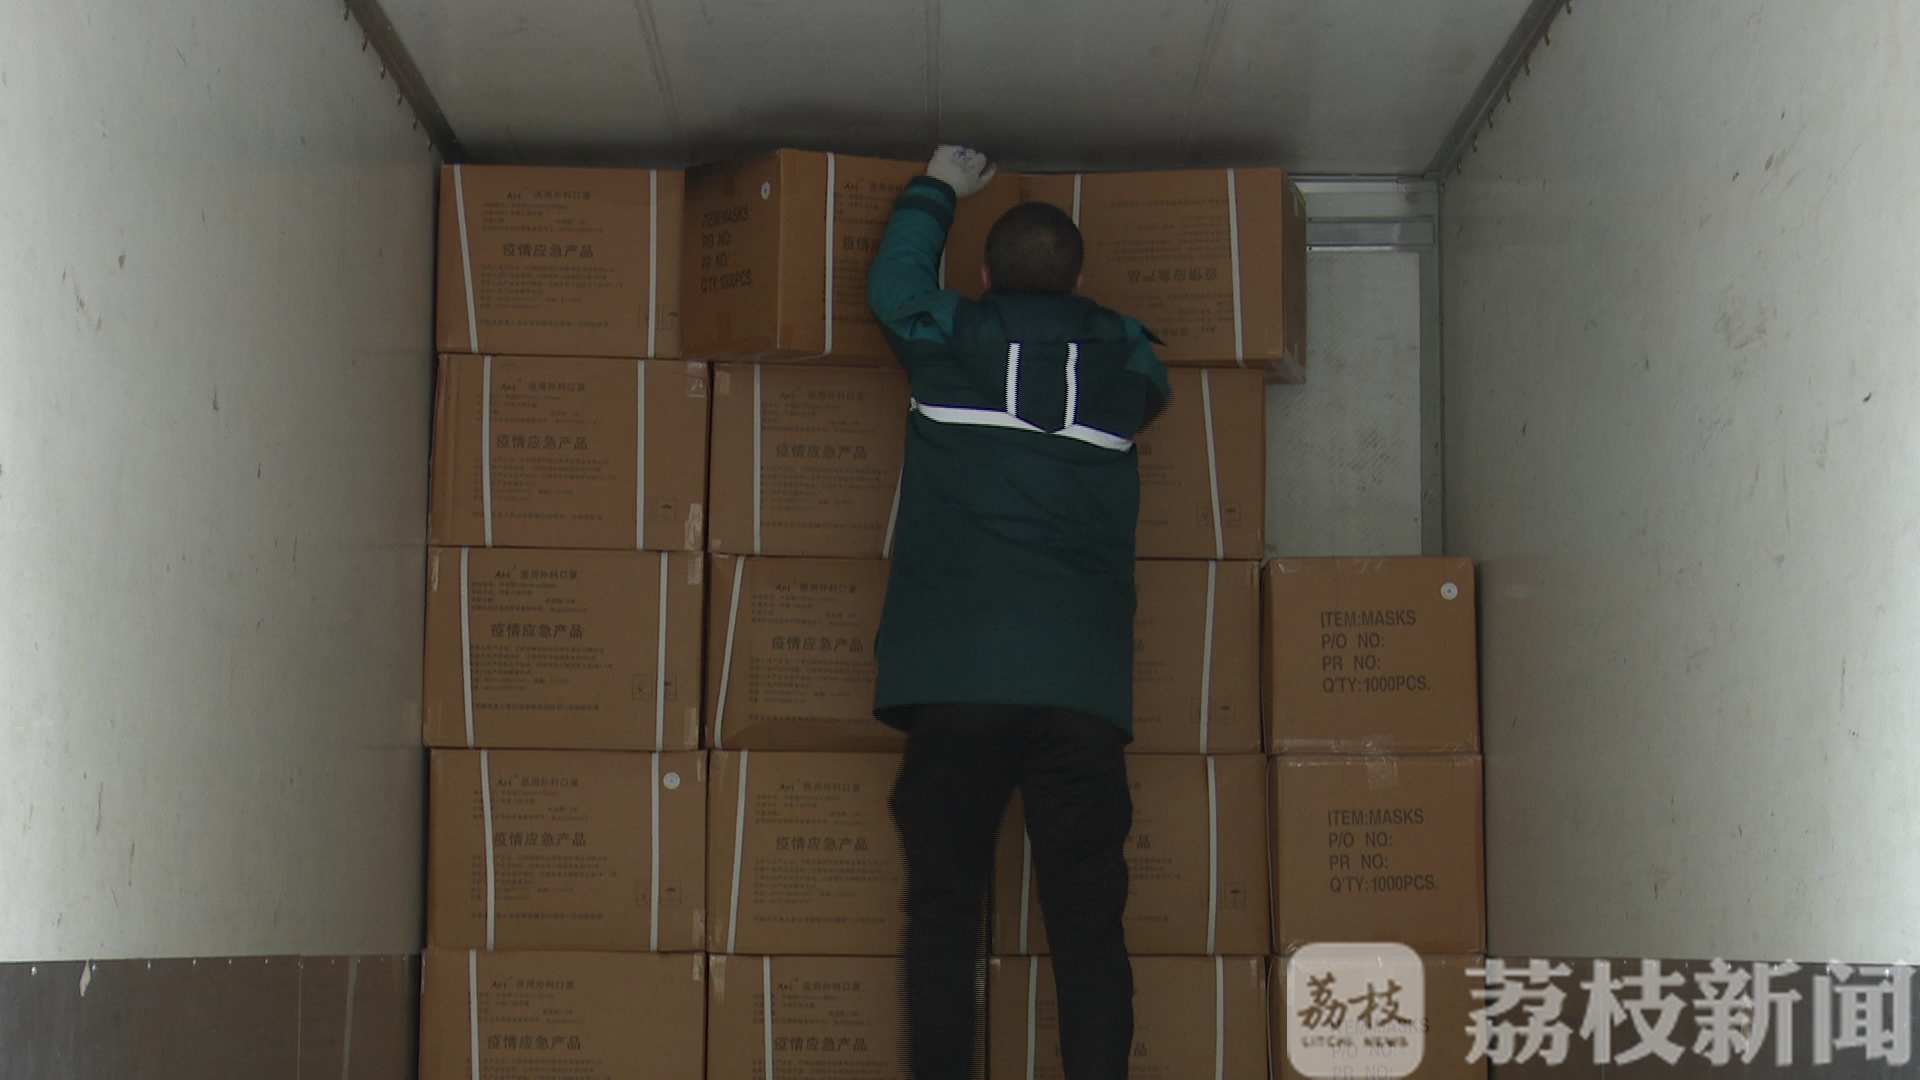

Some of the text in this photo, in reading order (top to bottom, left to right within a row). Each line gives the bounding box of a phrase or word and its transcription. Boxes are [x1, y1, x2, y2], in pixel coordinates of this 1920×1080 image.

[502, 241, 594, 258] 疫情应急产品
[701, 255, 712, 271] PR
[496, 434, 588, 450] 疫情应急产品
[775, 443, 868, 461] 疫情应急产品
[1320, 608, 1417, 628] ITEM:MASKS
[490, 623, 584, 639] 疫情应急产品
[771, 635, 864, 653] 疫情应急产品
[1321, 632, 1385, 650] P/O NO:
[1322, 654, 1381, 671] PR NO:
[1327, 808, 1424, 827] ITEM:MASKS
[493, 831, 587, 848] 疫情应急产品
[775, 836, 869, 852] 疫情应急产品
[1328, 831, 1393, 849] P/O NO:
[1329, 853, 1389, 870] PR NO:
[487, 1034, 582, 1051] 疫情应急产品
[773, 1035, 868, 1052] 疫情应急产品
